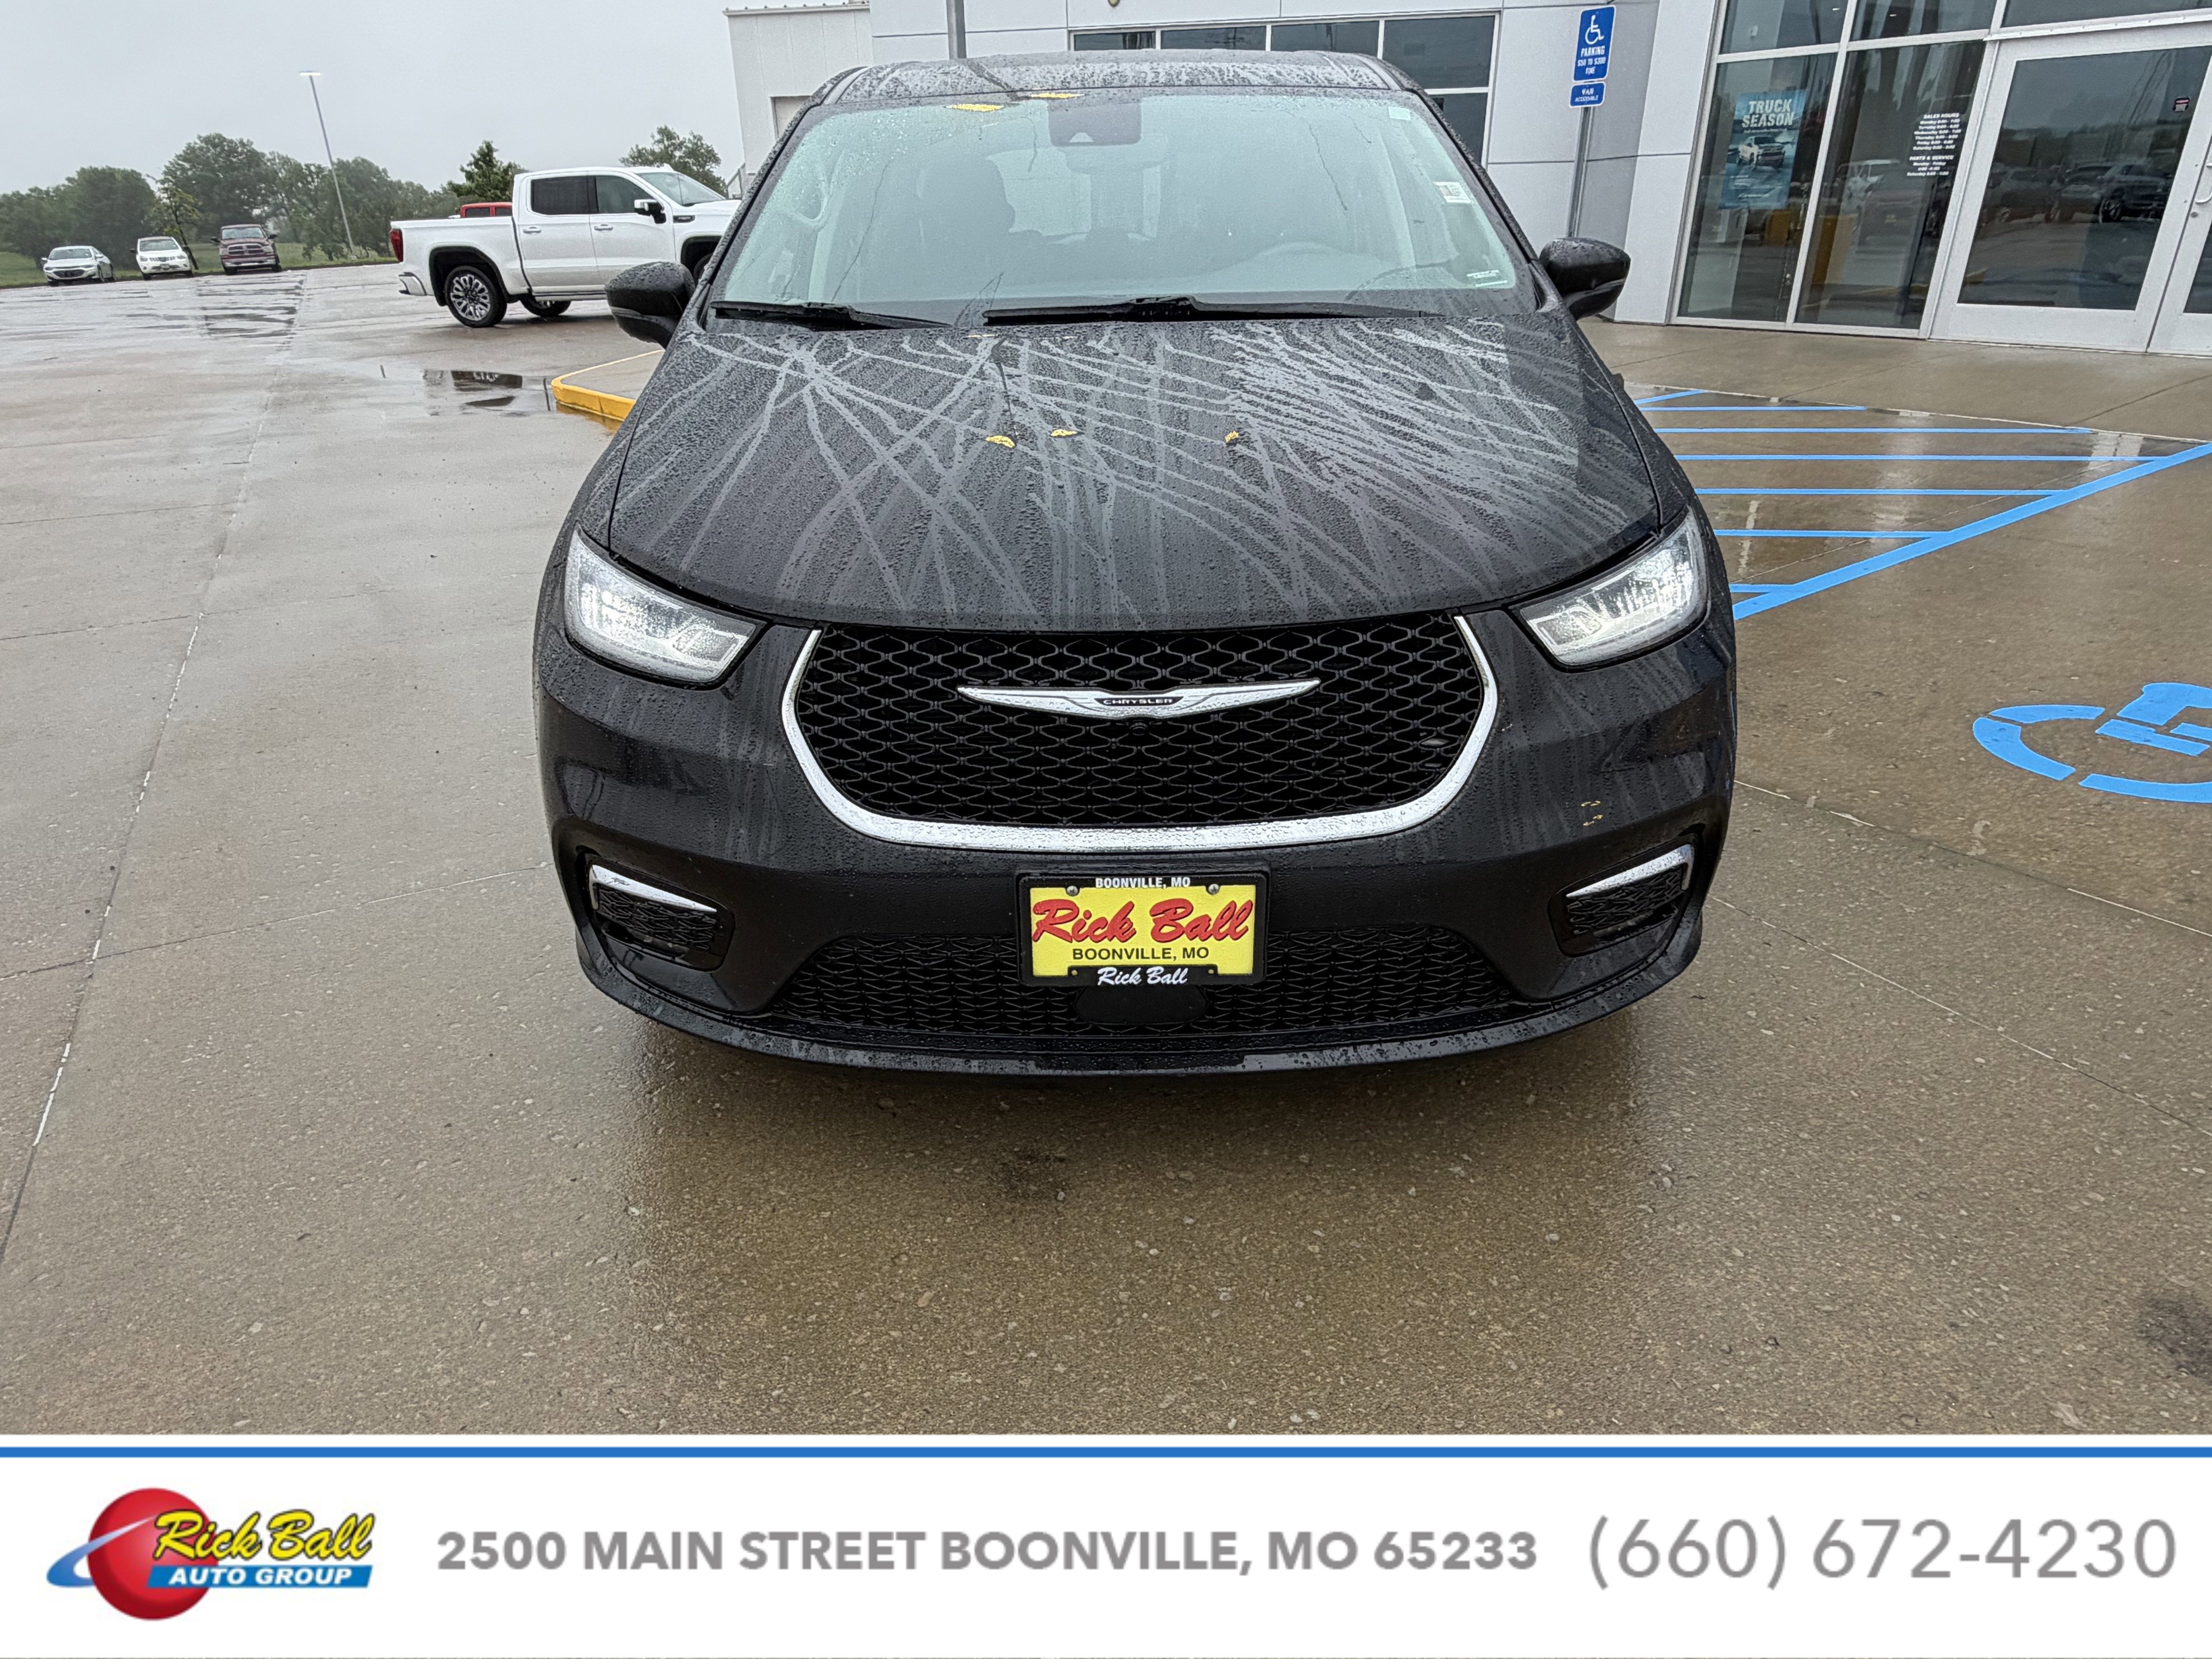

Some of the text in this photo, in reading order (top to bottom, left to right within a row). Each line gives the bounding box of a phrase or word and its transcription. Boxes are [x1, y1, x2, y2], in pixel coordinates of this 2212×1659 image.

[1581, 46, 1605, 57] PARKING
[1748, 99, 1792, 114] TRUCK
[1741, 112, 1795, 128] SEASON
[1095, 877, 1190, 890] BOONVILLE, MO
[1032, 898, 1253, 943] Rick Ball
[1072, 947, 1209, 961] BOONVILLE, MO
[1097, 967, 1188, 985] Rick Ball
